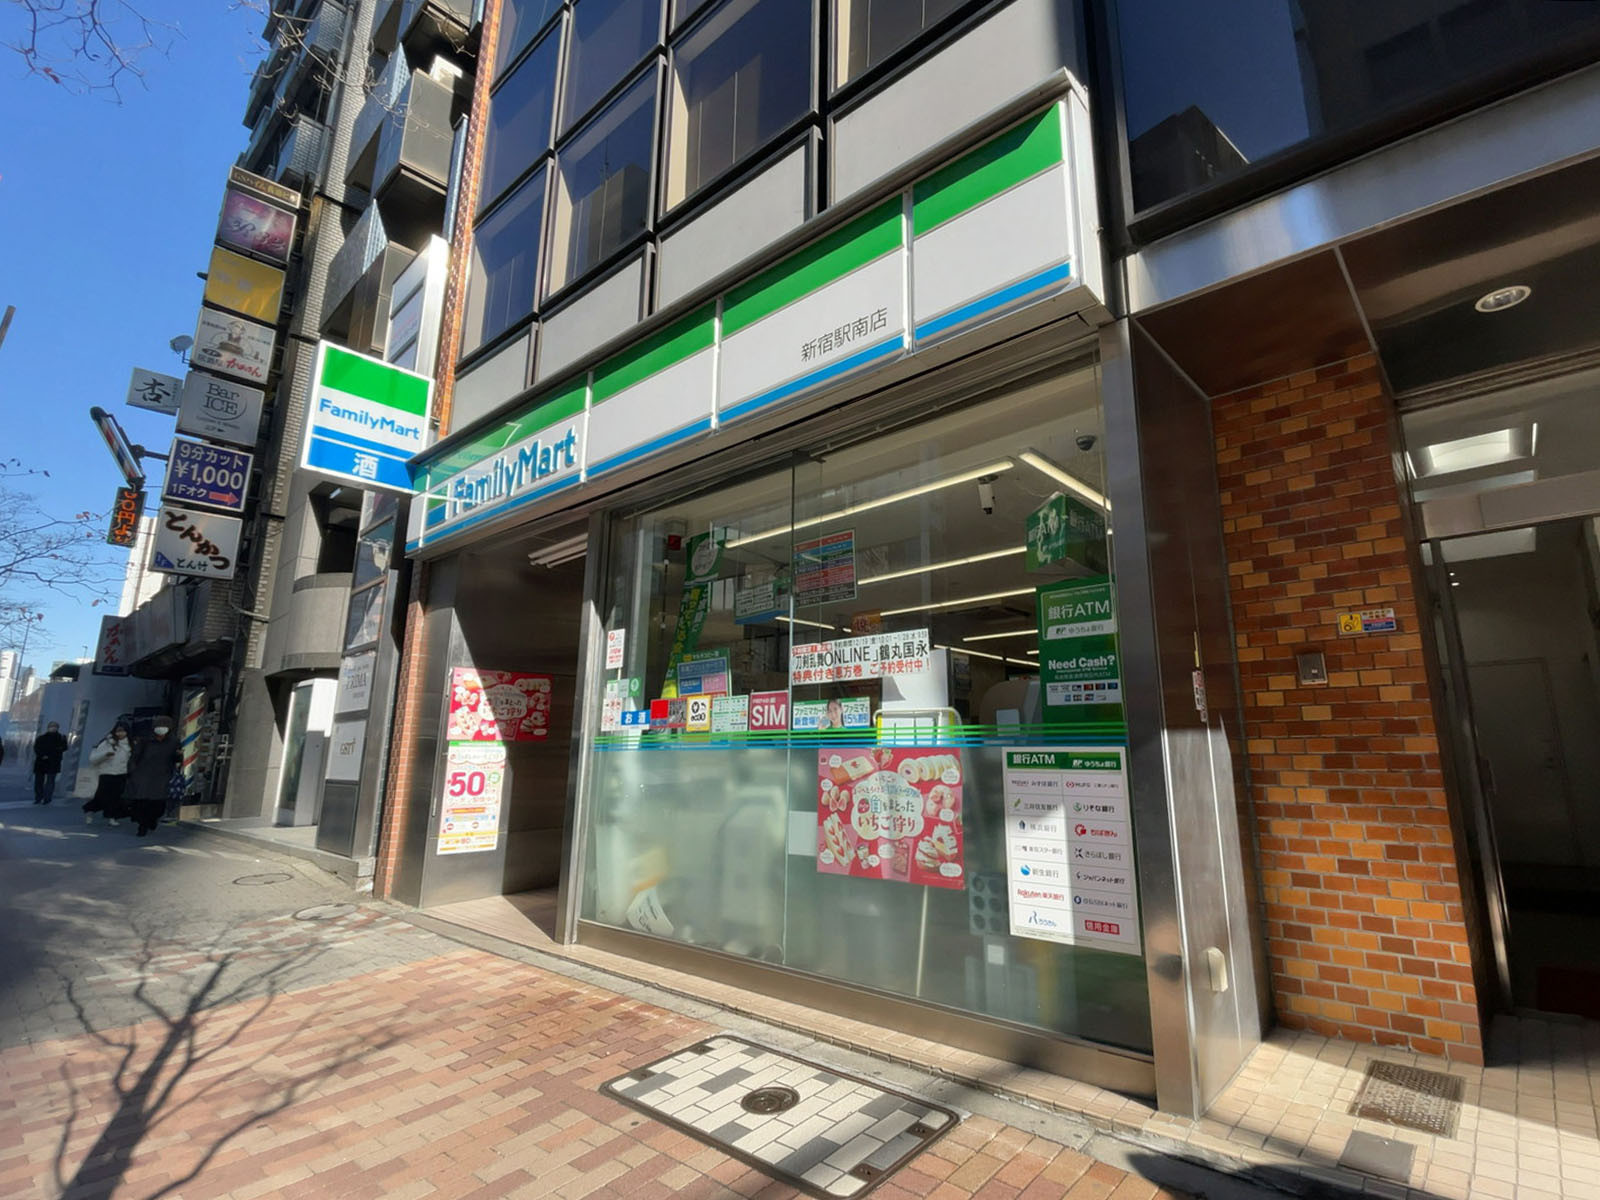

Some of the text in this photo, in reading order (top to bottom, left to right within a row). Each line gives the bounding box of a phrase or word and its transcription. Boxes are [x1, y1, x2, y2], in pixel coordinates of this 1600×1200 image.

[801, 308, 888, 363] 新宿駅南店
[207, 382, 240, 401] Bar
[202, 396, 238, 417] ICE
[319, 398, 420, 440] FamilyMart
[180, 443, 244, 470] 9分カット
[352, 452, 379, 480] 酒
[452, 427, 578, 504] FamilyMart
[174, 459, 244, 490] ¥1,000
[164, 511, 231, 570] とんかつ
[1047, 599, 1111, 620] 銀行ATM
[1048, 655, 1115, 671] Need Cash?
[752, 704, 786, 727] SIM
[1013, 754, 1055, 765] 銀行ATM
[1084, 760, 1117, 768] ゆうちょ銀行
[449, 771, 486, 797] 50
[1083, 804, 1115, 813] りそな銀行
[858, 815, 917, 833] いちご狩り
[1085, 851, 1121, 861] きらぼし銀行
[1032, 868, 1059, 878] 新生銀行
